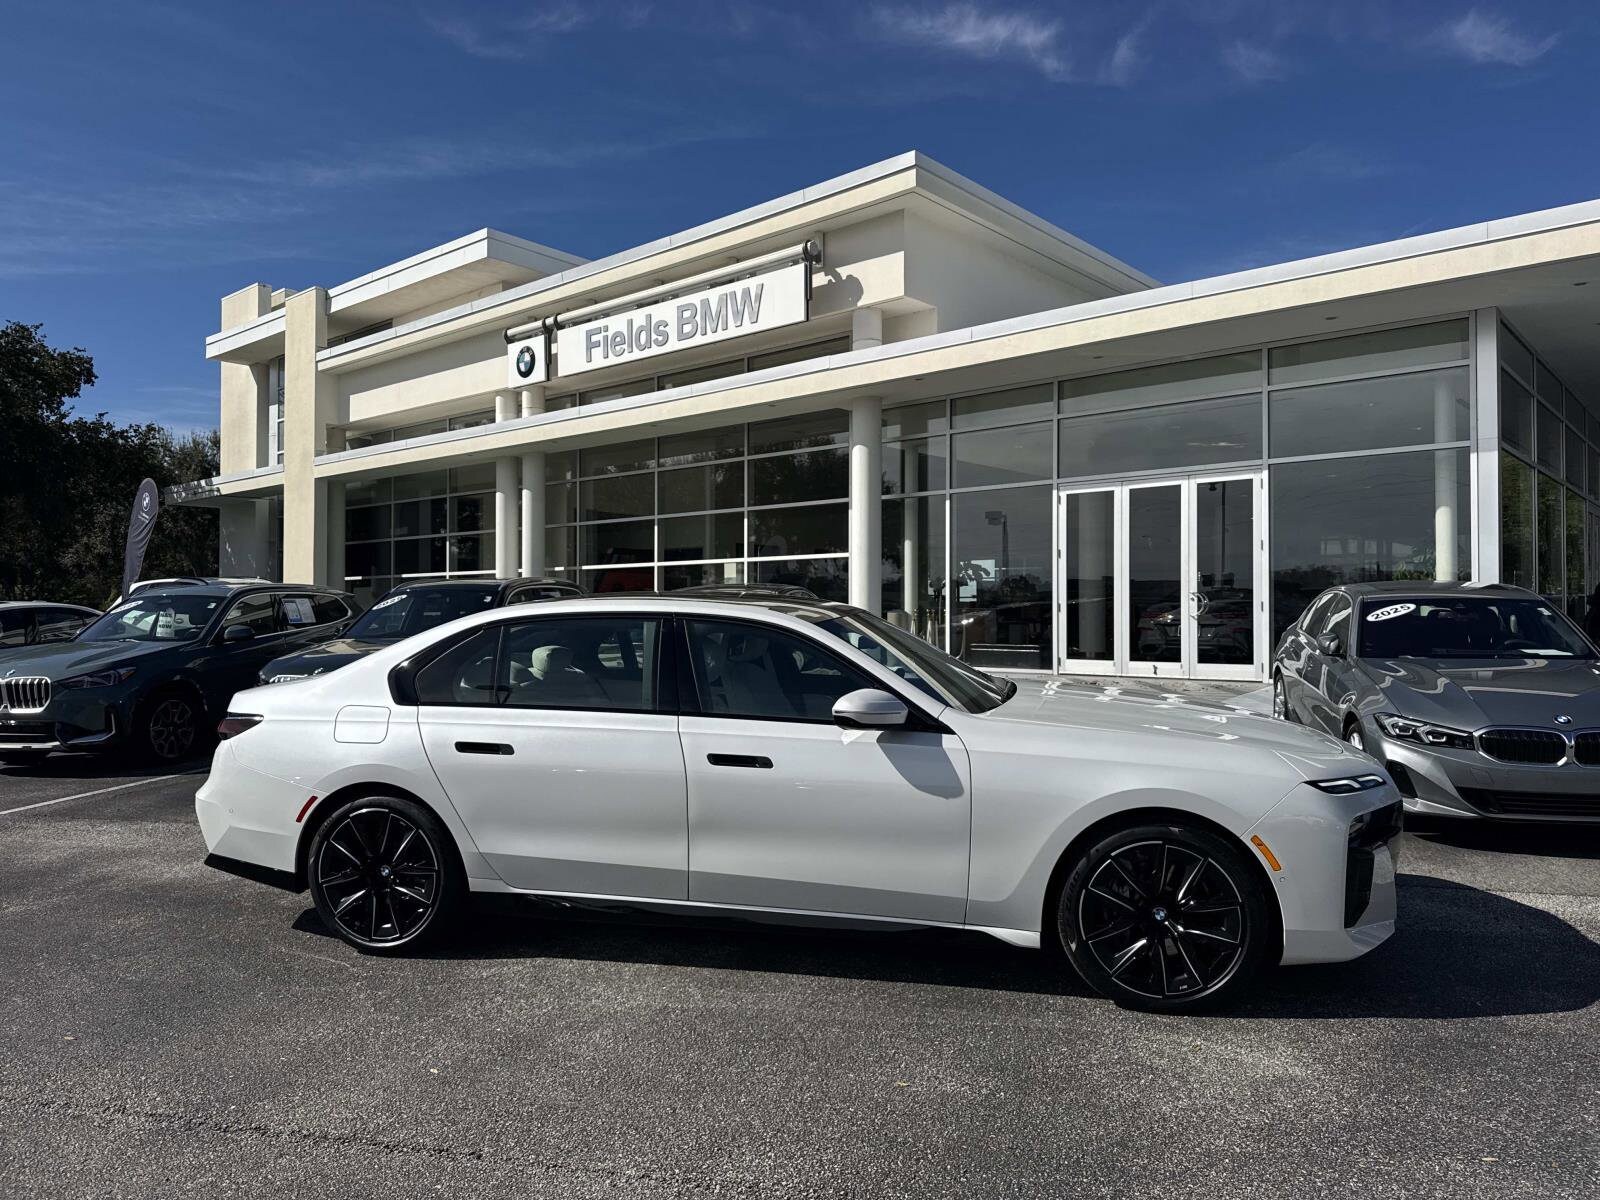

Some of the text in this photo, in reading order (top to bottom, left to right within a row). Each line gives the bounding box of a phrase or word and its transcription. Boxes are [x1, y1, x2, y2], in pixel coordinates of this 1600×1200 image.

[585, 283, 764, 363] Fields BMW
[1371, 604, 1410, 620] 2025
